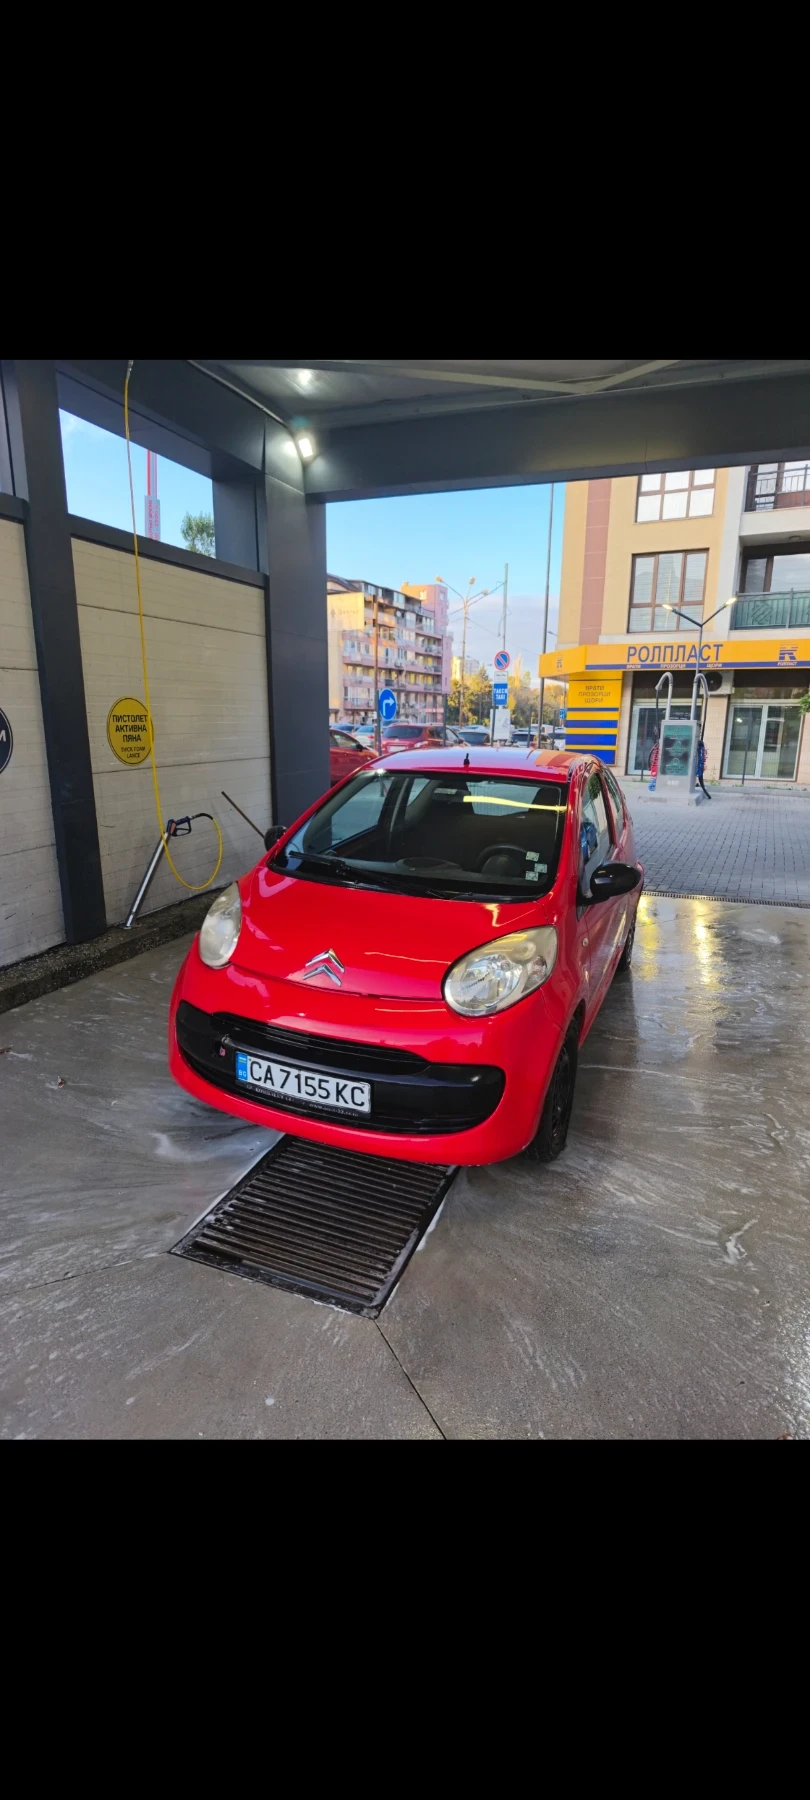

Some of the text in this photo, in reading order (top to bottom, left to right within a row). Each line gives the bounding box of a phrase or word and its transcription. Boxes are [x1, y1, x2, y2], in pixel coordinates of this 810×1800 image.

[627, 644, 723, 662] РОЛПЛАСТ
[112, 714, 147, 722] ПИСТОЛЕТ
[115, 724, 147, 732] АКТИВНА
[122, 734, 141, 742] ПЯНА
[238, 1069, 247, 1078] BG
[250, 1061, 275, 1087] CA
[280, 1069, 330, 1100] 7155
[335, 1082, 365, 1107] KC
